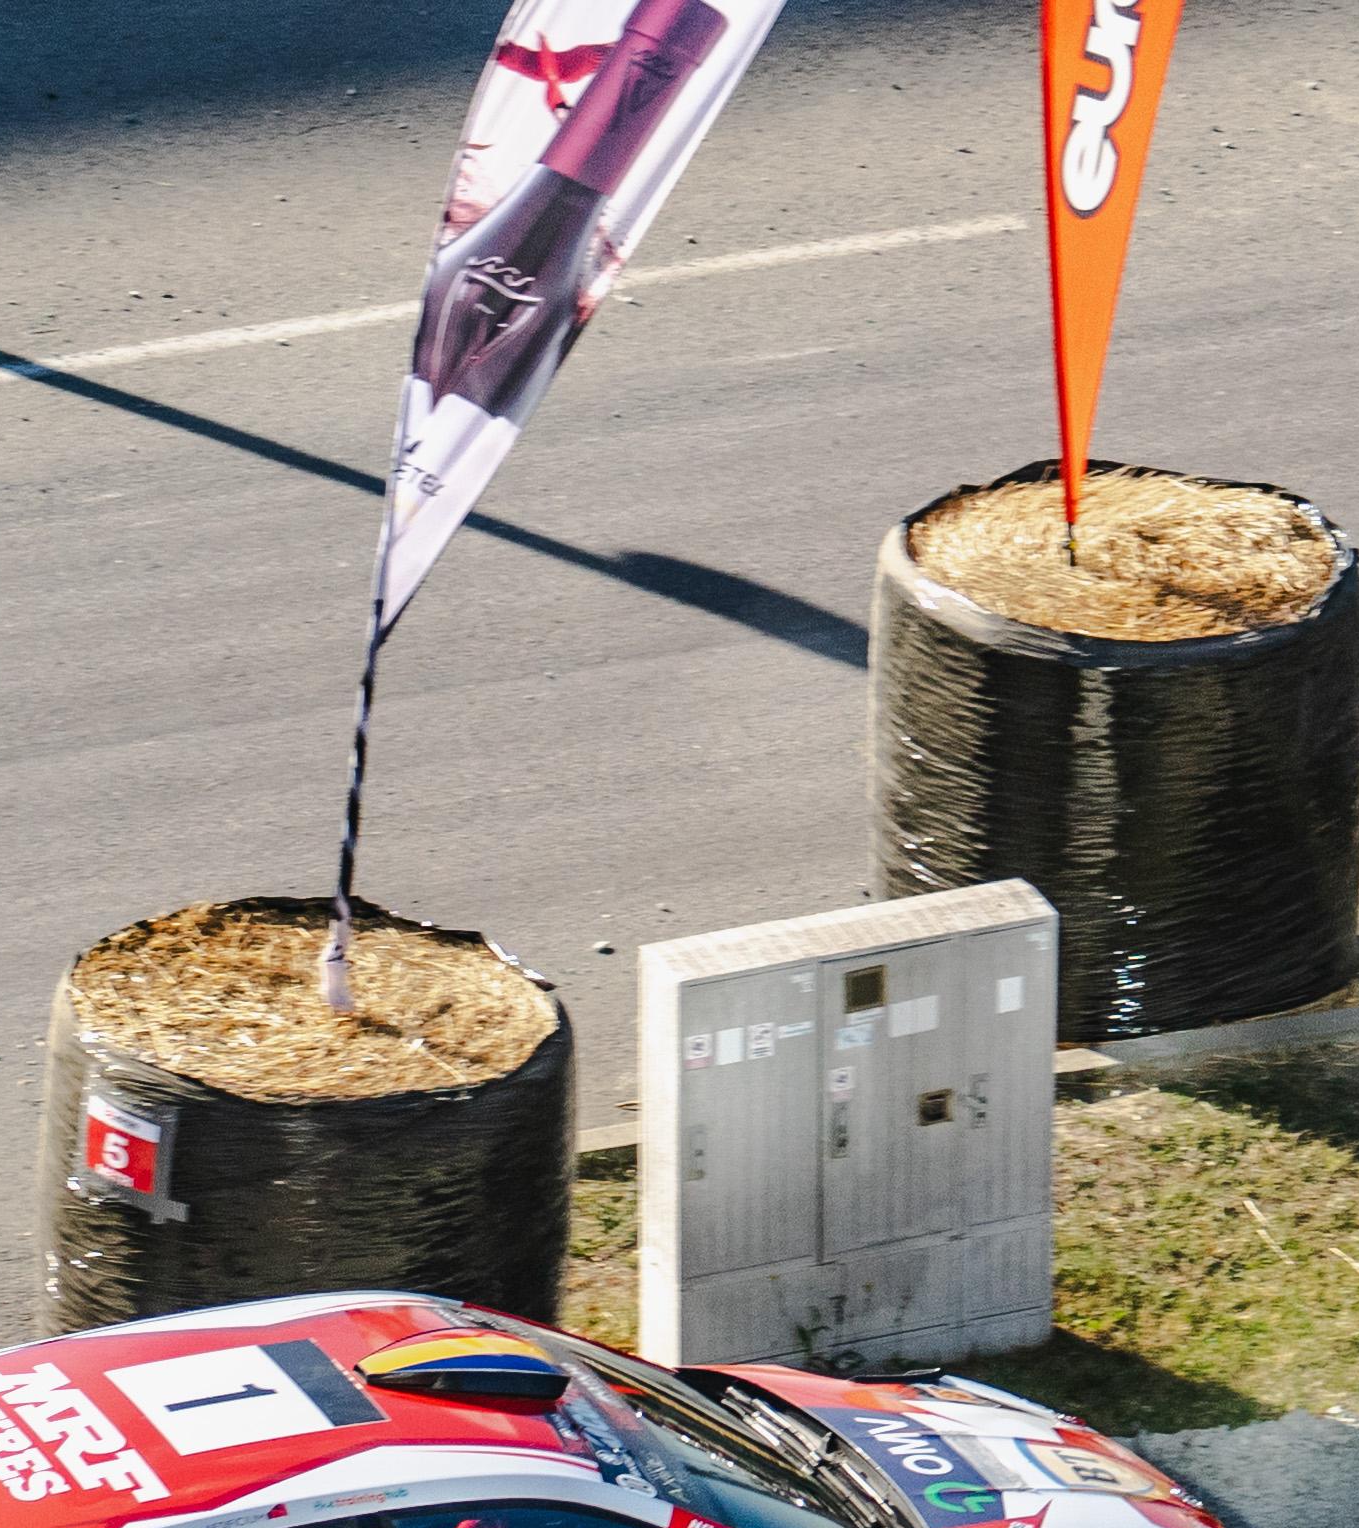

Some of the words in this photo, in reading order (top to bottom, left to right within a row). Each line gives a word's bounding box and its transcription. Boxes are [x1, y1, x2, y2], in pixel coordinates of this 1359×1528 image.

[102, 1132, 129, 1169] 5
[163, 1383, 279, 1413] 1
[853, 1416, 954, 1476] OMV
